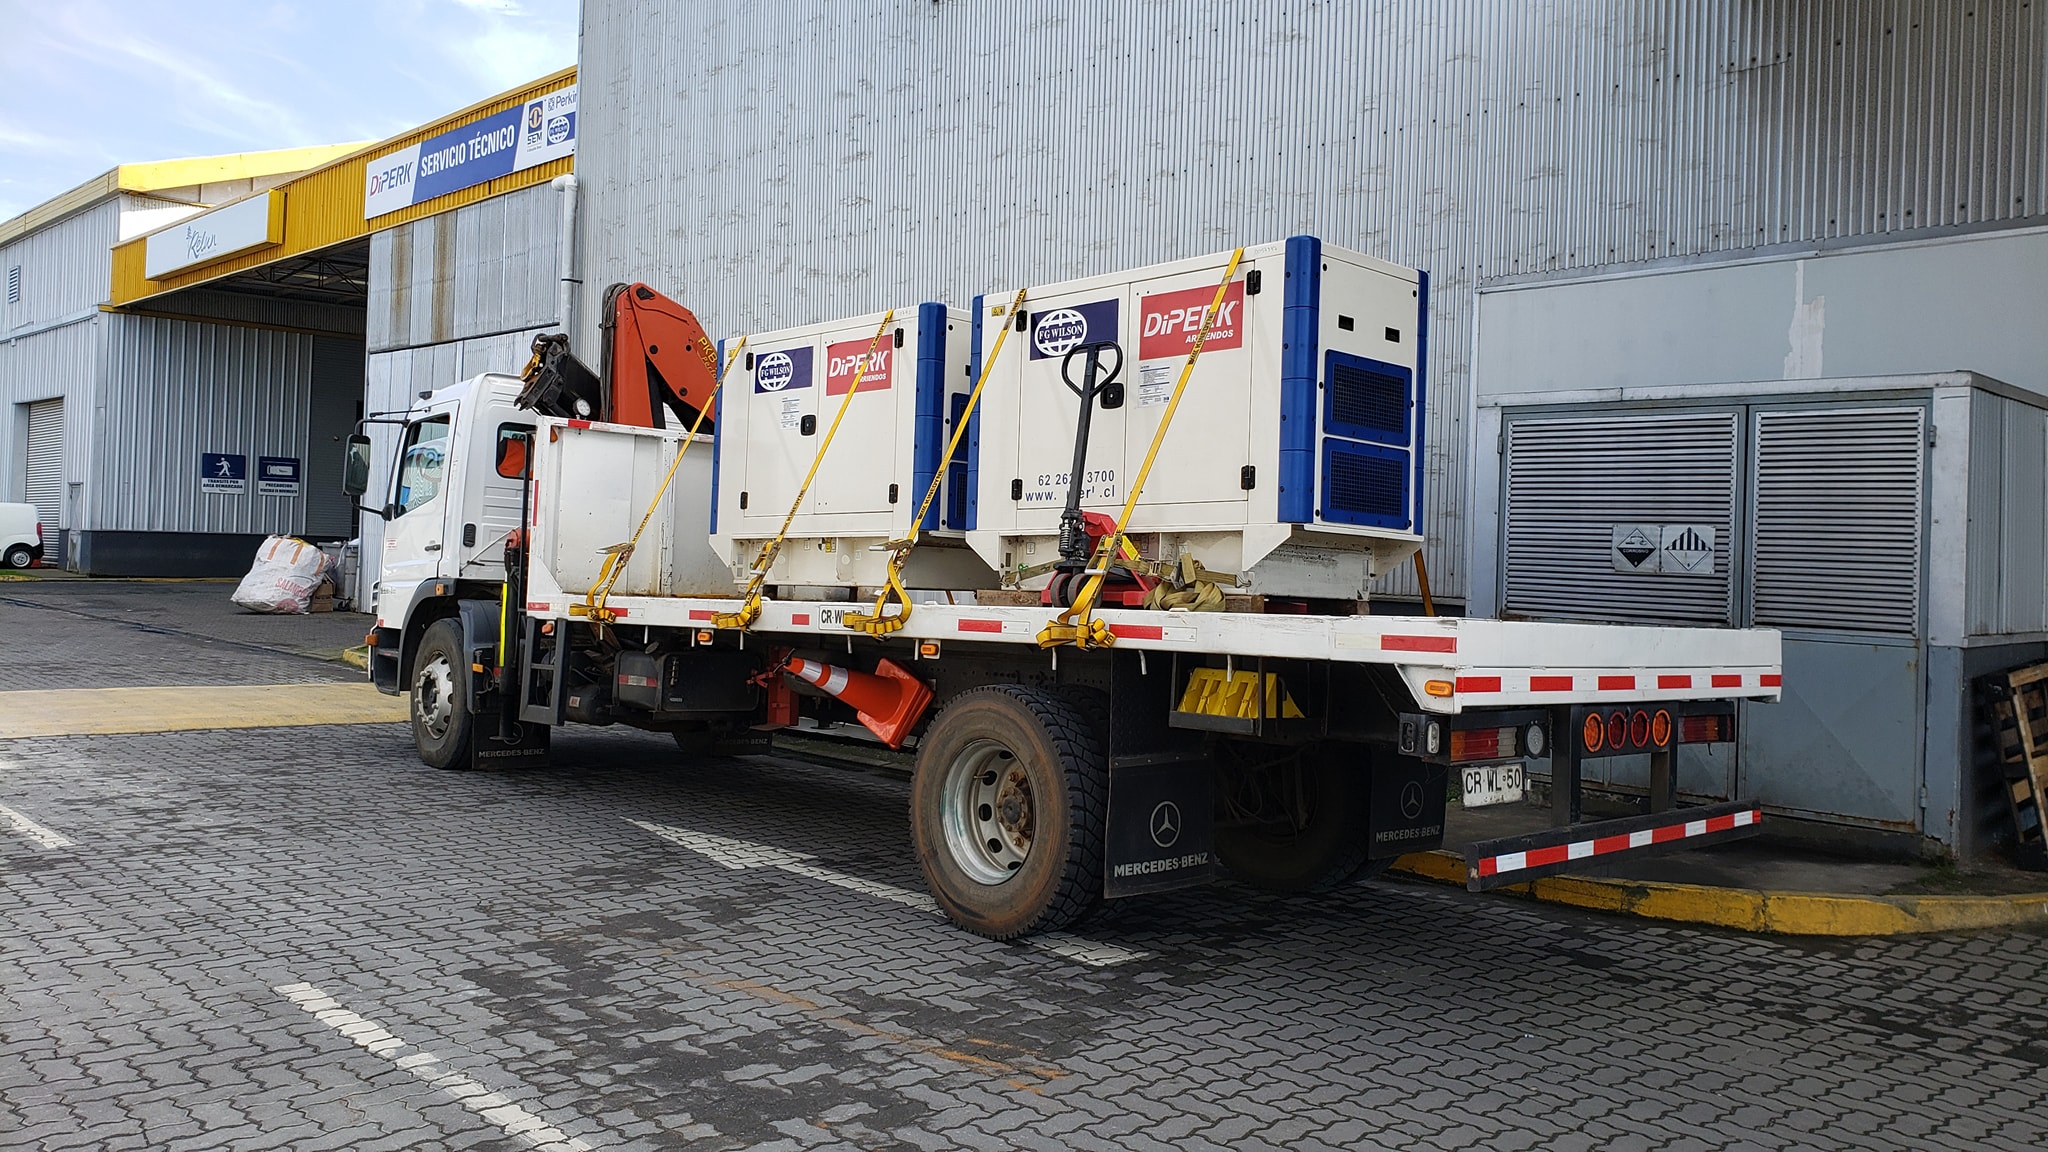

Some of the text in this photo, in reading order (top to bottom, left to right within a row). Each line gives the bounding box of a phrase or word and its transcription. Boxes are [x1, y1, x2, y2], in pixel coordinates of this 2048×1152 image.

[527, 132, 543, 145] SEM
[421, 124, 515, 177] SERVICIO TÉCNICO
[370, 162, 413, 196] DiPERK
[1039, 324, 1083, 340] FG WILSON
[1185, 329, 1234, 343] ARENDOS
[761, 365, 790, 377] FG WILSON
[1038, 474, 1051, 486] 62
[1087, 470, 1114, 483] 3700
[1375, 825, 1441, 843] MERCEDES-BENZ
[1114, 852, 1209, 878] MERCEDES-BENZ
